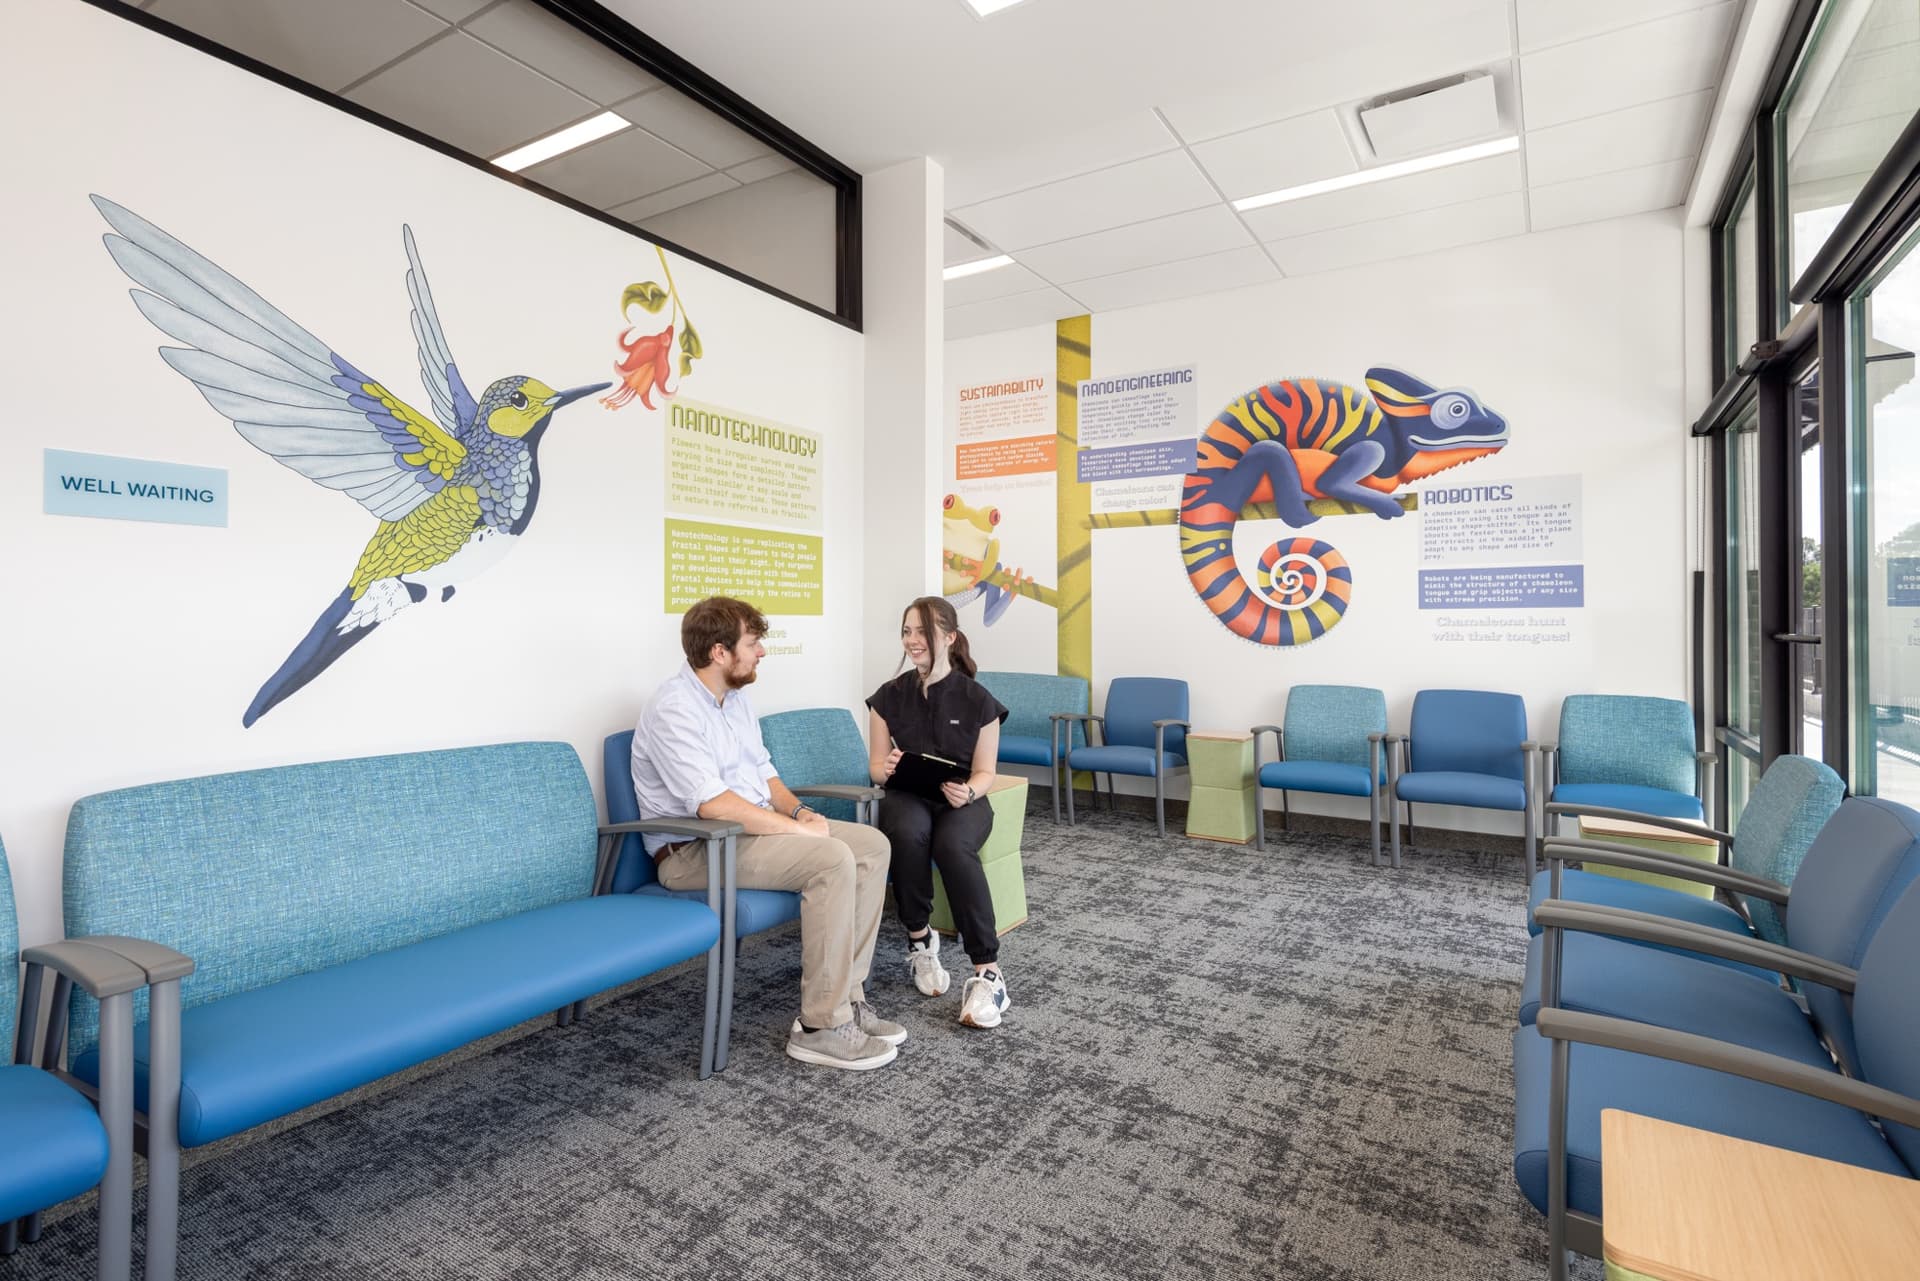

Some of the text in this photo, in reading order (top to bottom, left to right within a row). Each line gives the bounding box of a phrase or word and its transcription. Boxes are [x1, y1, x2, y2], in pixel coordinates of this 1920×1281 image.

[960, 378, 1043, 401] SUSTAINABILITY
[1082, 370, 1192, 397] NANOENGINEERING
[672, 404, 816, 458] NANOTECHNOLOGY
[61, 475, 214, 502] WELL WAITING
[1096, 484, 1175, 496] Chameleons can
[1424, 485, 1512, 505] ROBOTICS
[1102, 496, 1167, 508] change color!
[1462, 521, 1521, 529] shape-shifter.
[1437, 616, 1566, 627] Chameleons hunt
[1432, 631, 1571, 645] with their tongues!
